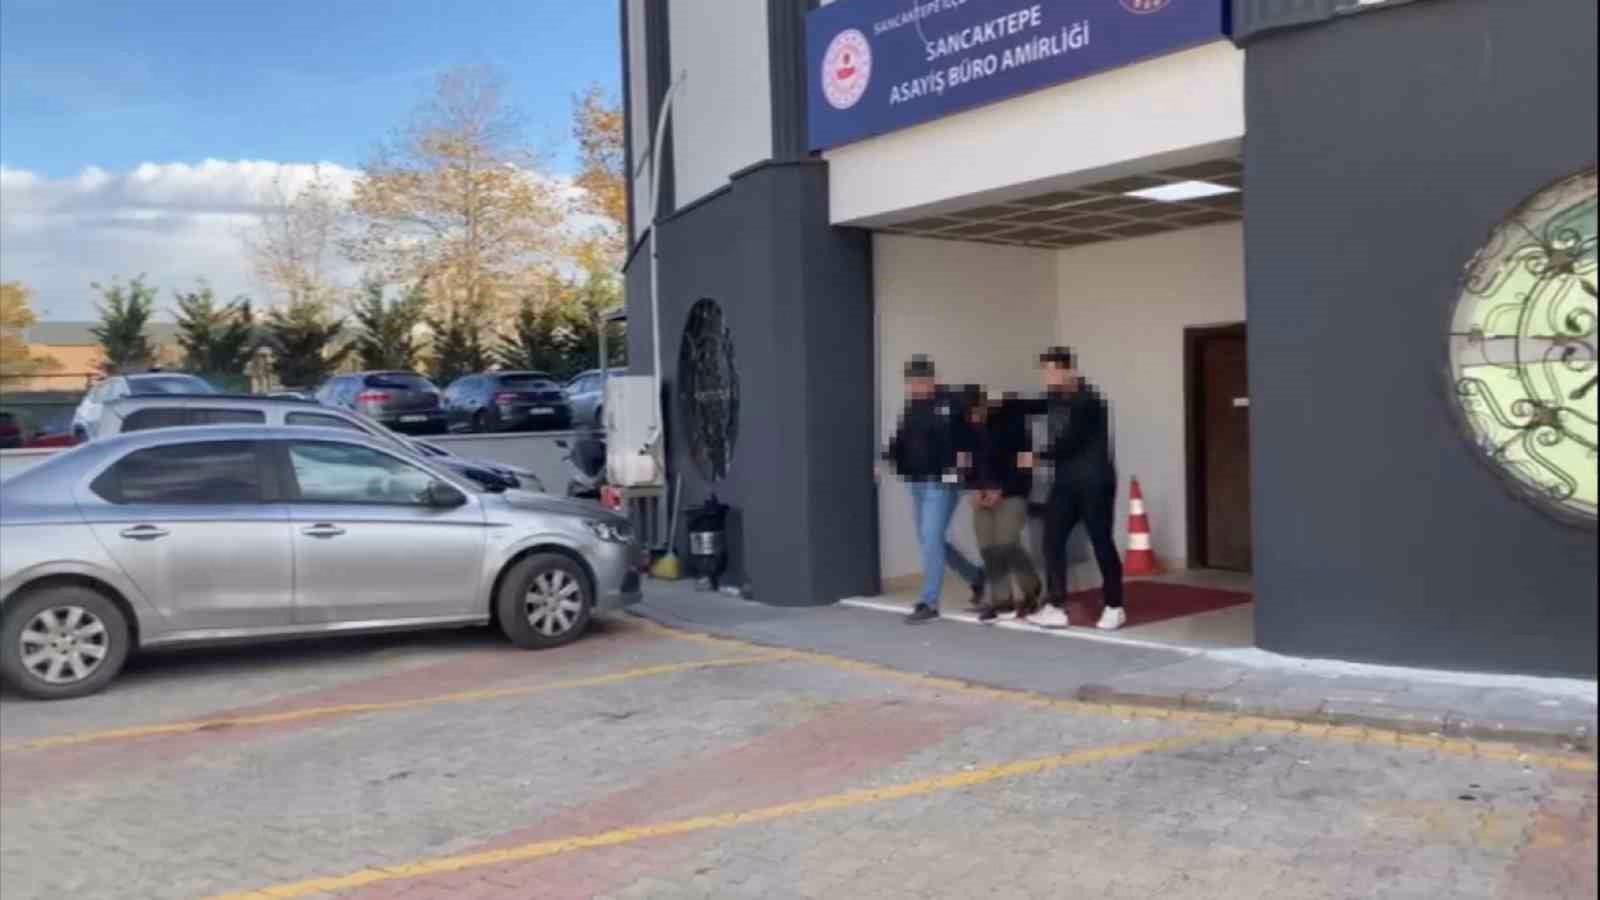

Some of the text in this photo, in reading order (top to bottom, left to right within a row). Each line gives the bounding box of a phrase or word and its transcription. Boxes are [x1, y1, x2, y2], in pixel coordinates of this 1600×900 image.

[889, 20, 1090, 104] ASAYİŞ BÜRO AMİRLİĞİ
[926, 5, 1042, 61] SANCAKTEPE
